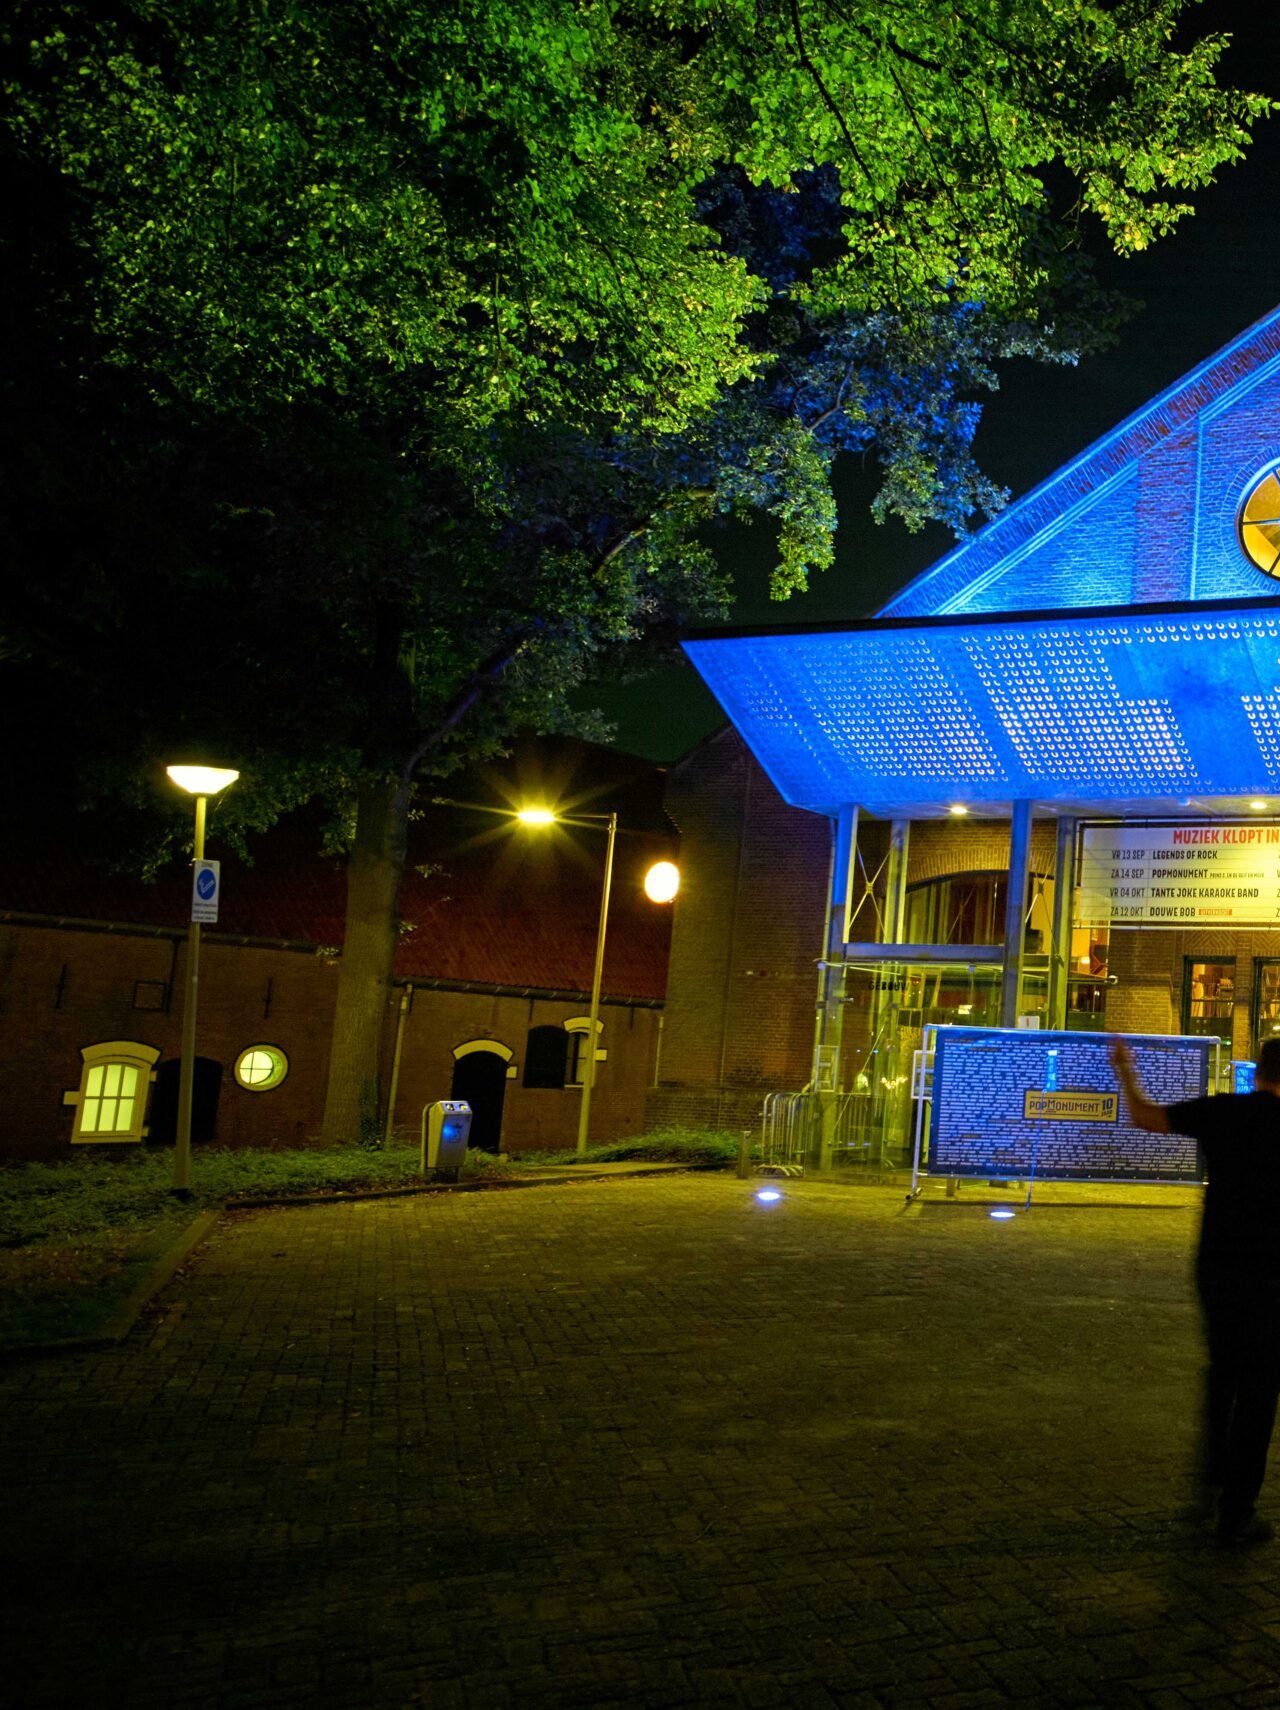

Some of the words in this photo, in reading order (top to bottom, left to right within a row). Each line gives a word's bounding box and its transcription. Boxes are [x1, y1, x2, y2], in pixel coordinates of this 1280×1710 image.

[1173, 829, 1219, 844] MUZIEK
[1222, 829, 1264, 844] KLOPT
[1266, 829, 1279, 843] IN
[1112, 850, 1121, 860] VR
[1122, 850, 1131, 860] 13
[1132, 850, 1146, 860] SEP
[1153, 850, 1185, 860] LEGENDS
[1186, 850, 1196, 860] OF
[1197, 850, 1218, 860] ROCK
[1111, 869, 1120, 878] ZA
[1121, 869, 1130, 878] 14
[1131, 869, 1145, 878] SEP
[1152, 869, 1209, 878] POPMONUMENT
[1110, 888, 1119, 897] VR
[1120, 888, 1130, 897] 04
[1131, 888, 1146, 897] OKT
[1151, 888, 1175, 897] TANTE
[1176, 888, 1197, 897] JOKE
[1199, 888, 1236, 897] KARAOKE
[1237, 888, 1259, 897] BAND
[1110, 907, 1119, 916] ZA
[1120, 907, 1129, 916] 12
[1130, 907, 1144, 916] OKT
[1150, 907, 1178, 916] DOUWE
[1179, 907, 1196, 916] BOB
[1029, 1099, 1099, 1113] POPMONUMENT
[1101, 1098, 1114, 1111] 10
